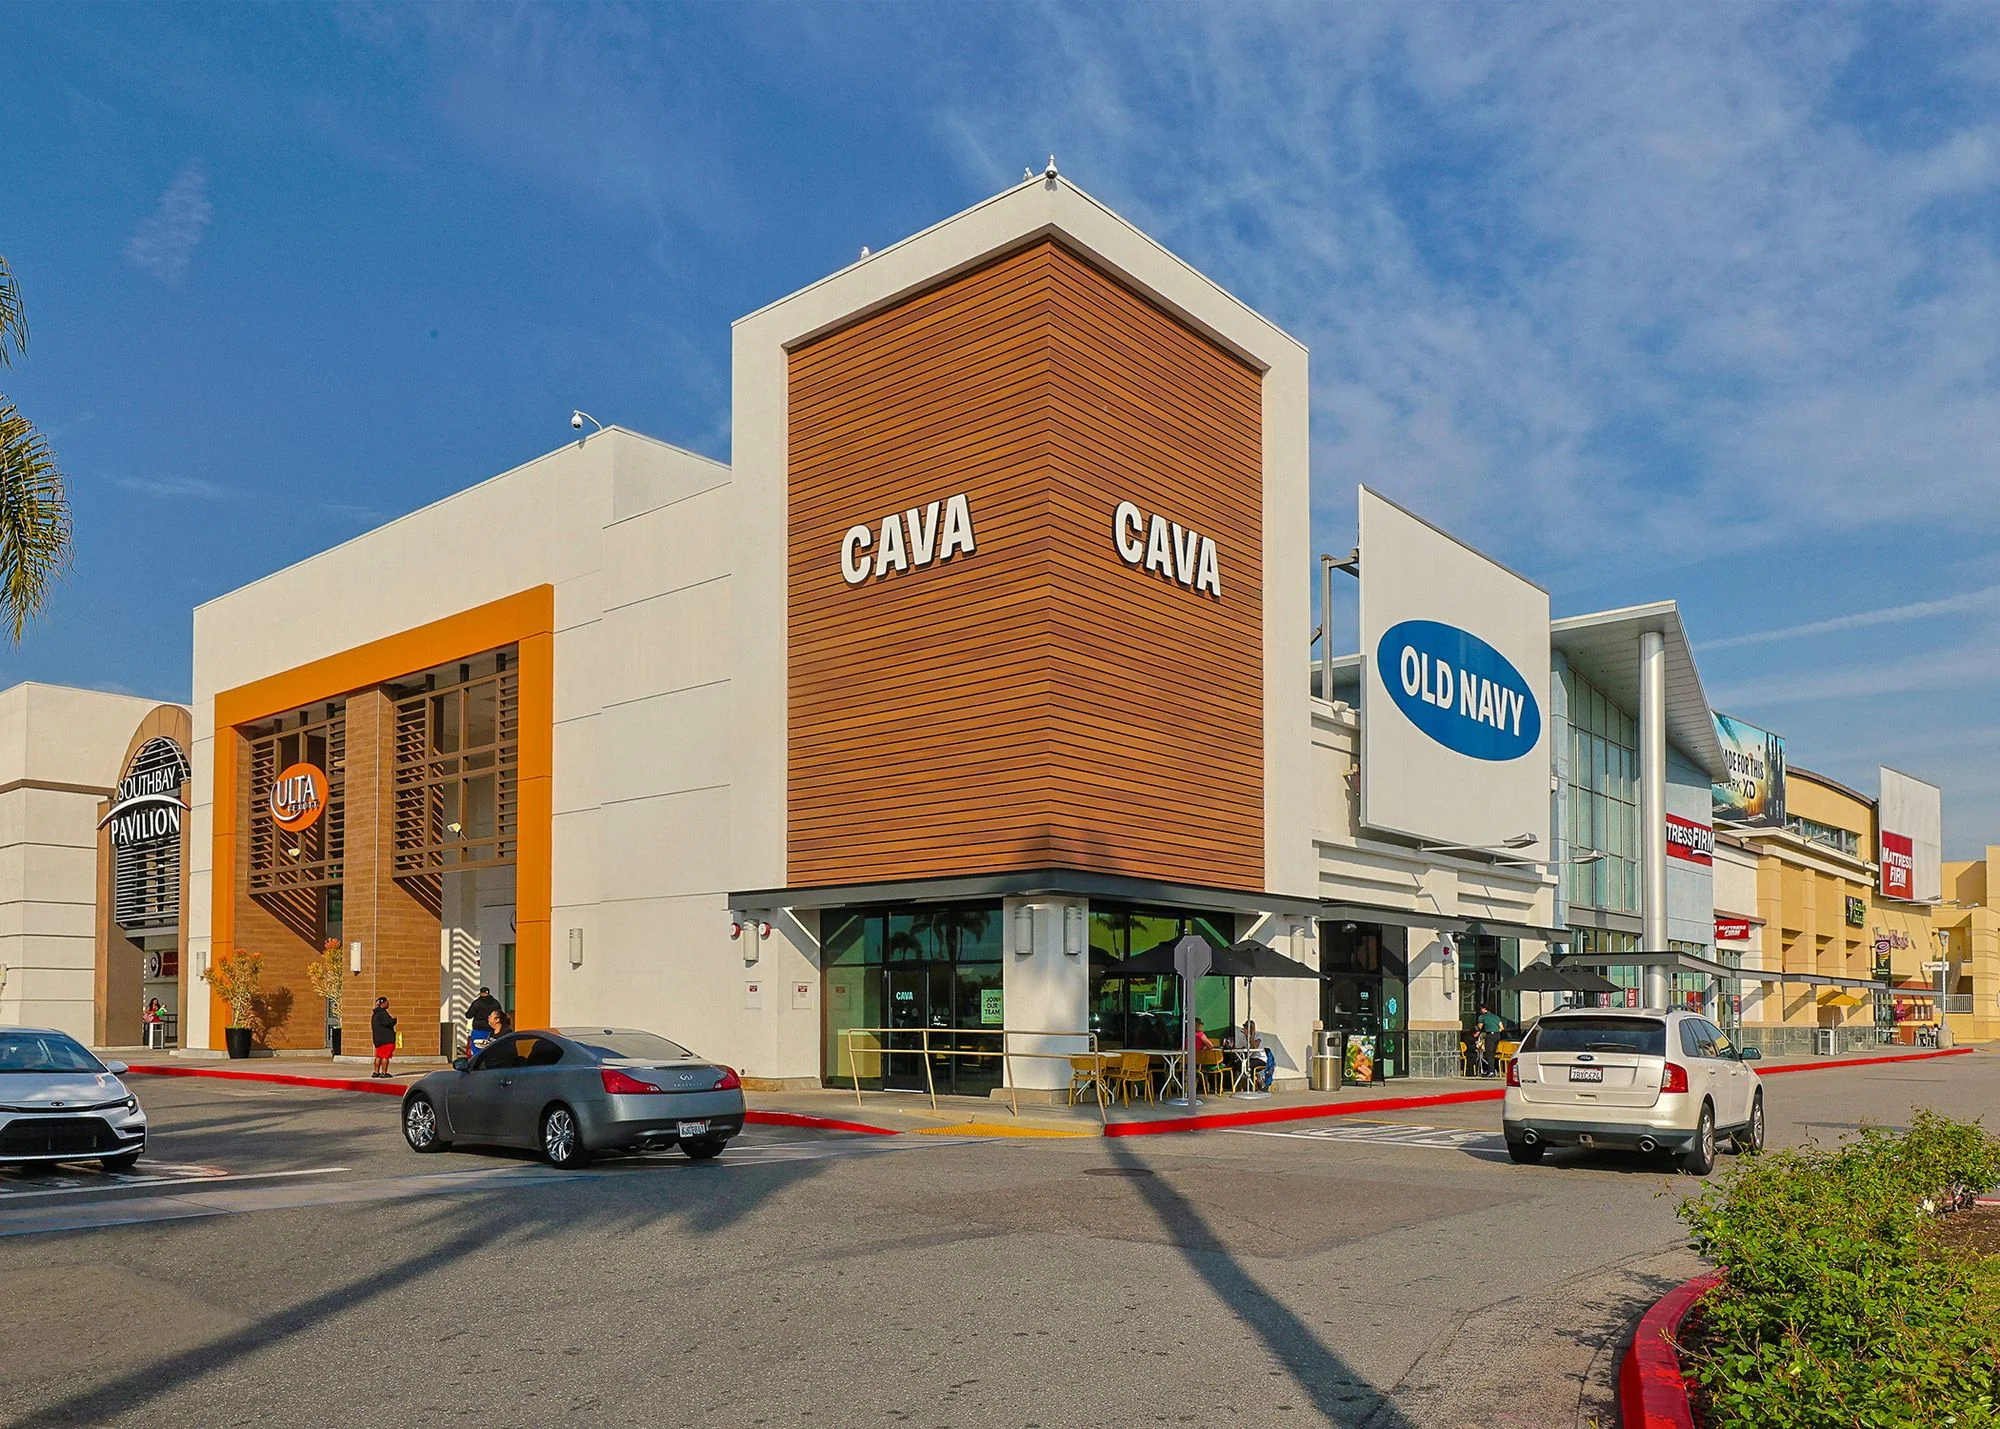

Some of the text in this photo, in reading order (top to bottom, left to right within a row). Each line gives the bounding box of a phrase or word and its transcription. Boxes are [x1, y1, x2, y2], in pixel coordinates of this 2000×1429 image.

[841, 493, 976, 585] CAVA
[1114, 501, 1221, 597] CAVA
[1401, 645, 1525, 737] OLD NAVY
[118, 766, 176, 801] SOUTHBAY
[1737, 753, 1749, 776] FOR
[1750, 758, 1764, 780] THIS
[276, 774, 316, 808] ULTA
[1743, 779, 1756, 799] XD
[111, 806, 180, 845] PAVILION
[1882, 847, 1912, 869] MATTRESS
[1890, 866, 1907, 884] FIRM
[896, 991, 914, 1000] CAVA
